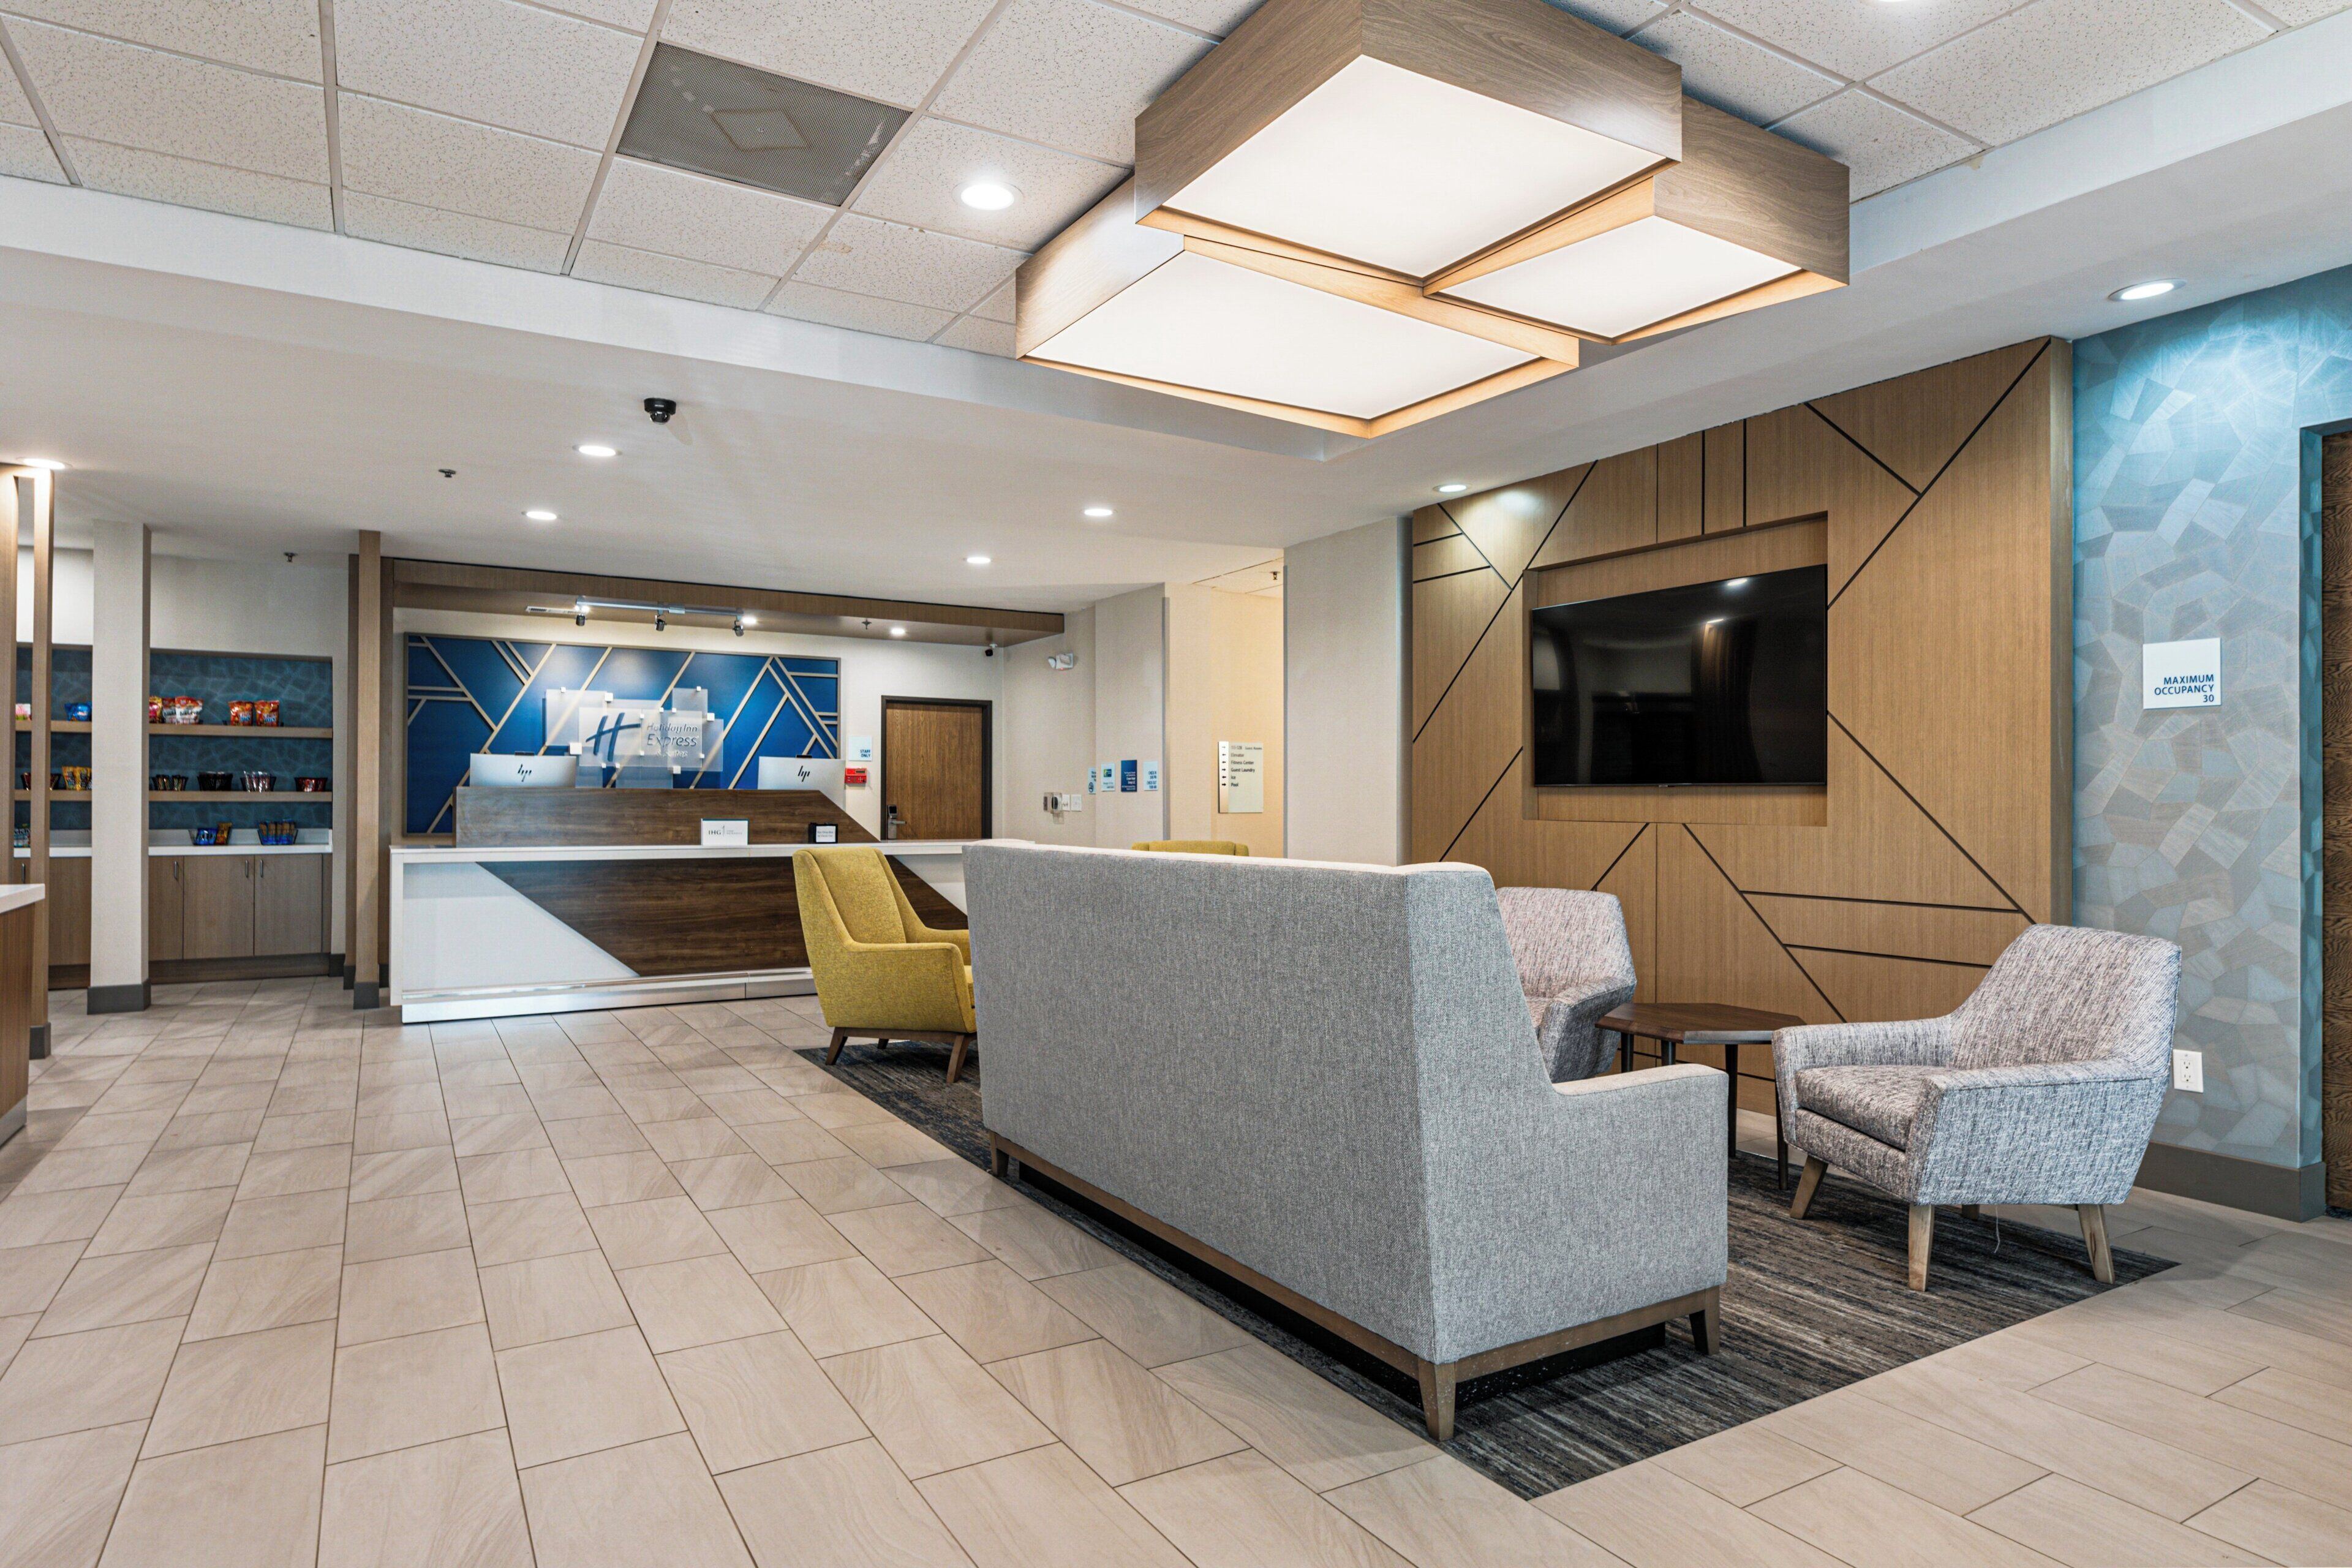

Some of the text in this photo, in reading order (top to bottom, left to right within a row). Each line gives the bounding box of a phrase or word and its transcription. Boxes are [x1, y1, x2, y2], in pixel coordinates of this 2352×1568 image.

[2164, 674, 2214, 685] MAXIMUM
[2154, 684, 2214, 695] OCCUPANCY
[647, 723, 682, 733] Holiday
[647, 733, 697, 747] Express
